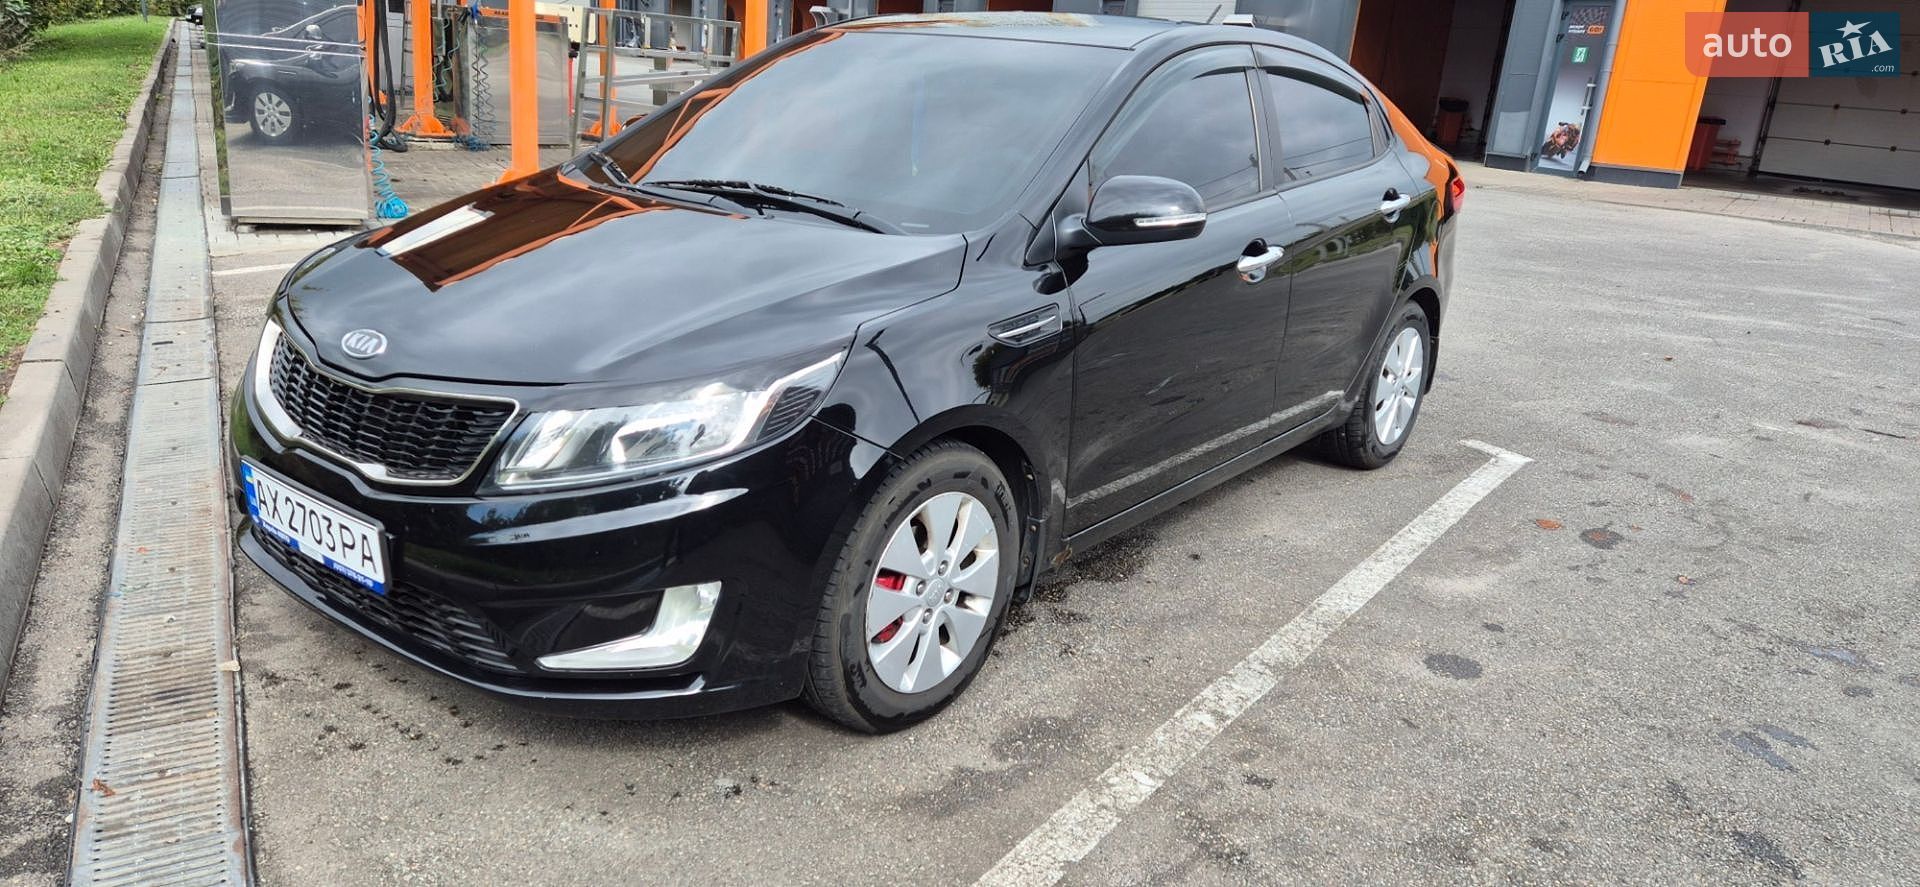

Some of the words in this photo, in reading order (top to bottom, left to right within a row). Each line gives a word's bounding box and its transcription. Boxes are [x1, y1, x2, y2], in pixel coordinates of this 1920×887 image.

[347, 333, 378, 354] KIA
[257, 480, 283, 525] AX
[285, 496, 336, 553] 2703
[338, 522, 377, 574] PA
